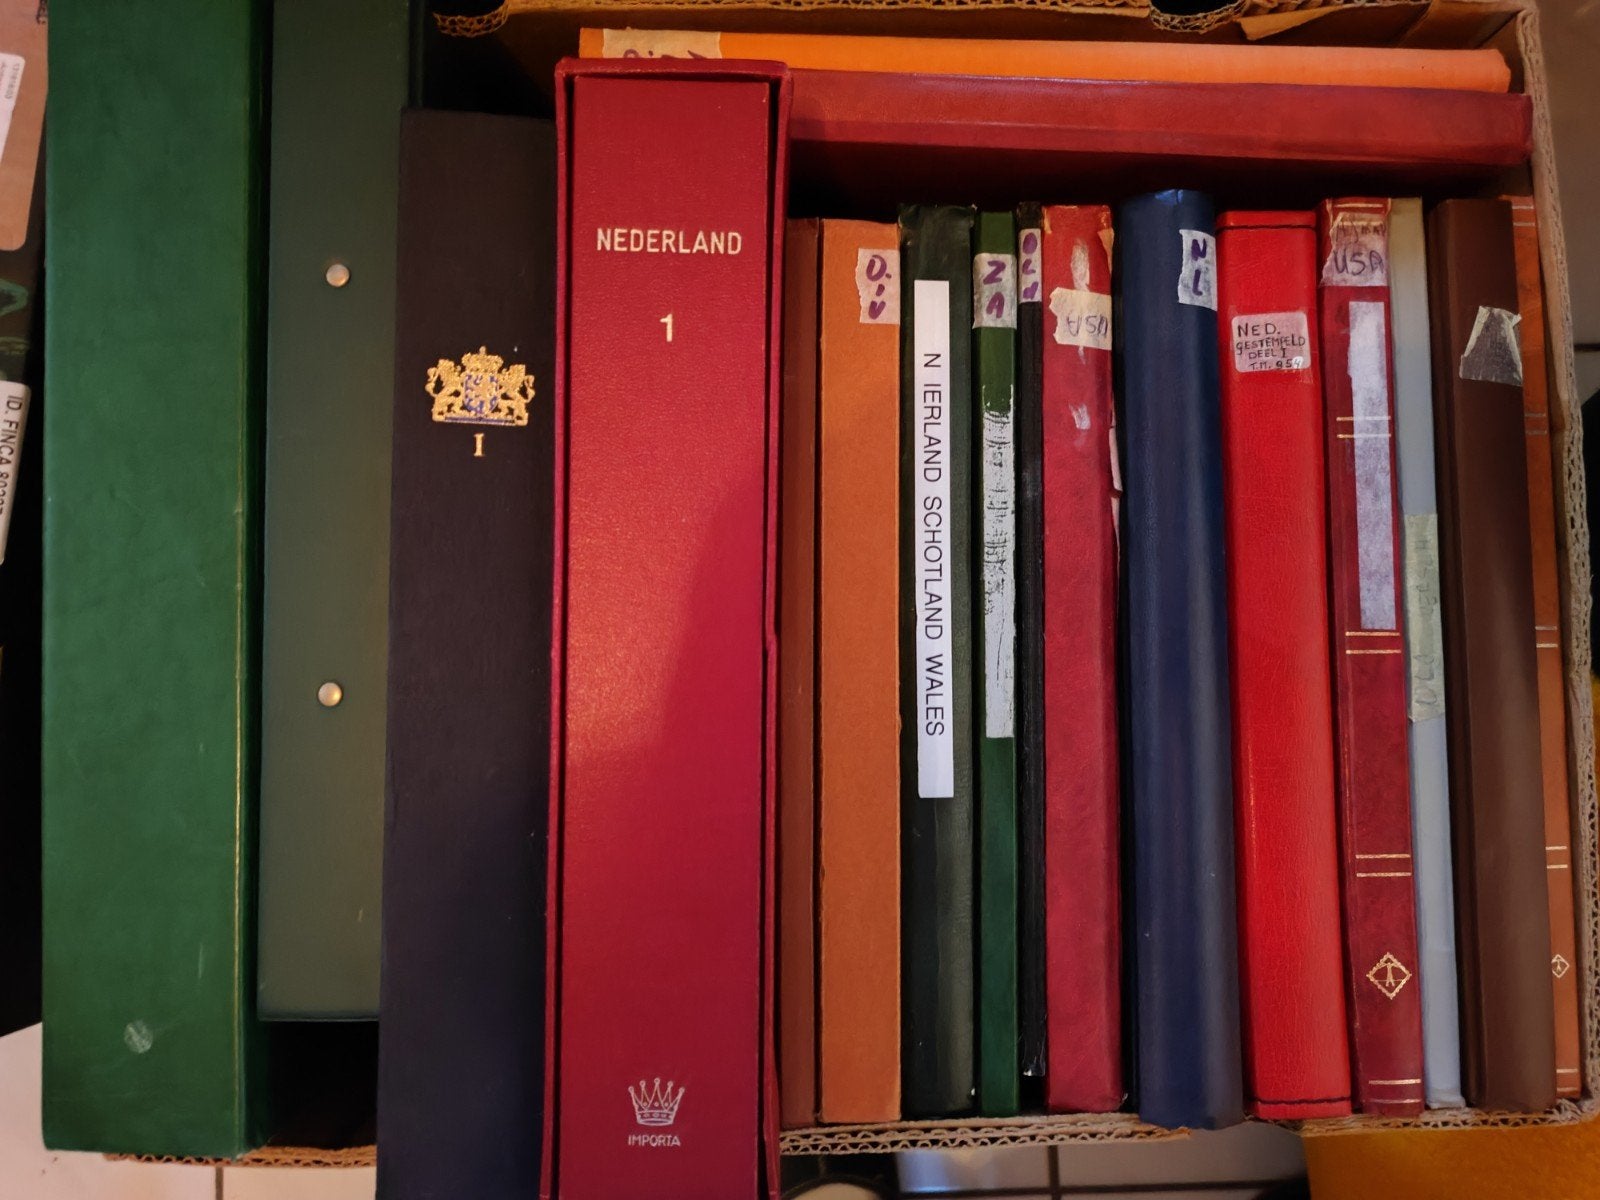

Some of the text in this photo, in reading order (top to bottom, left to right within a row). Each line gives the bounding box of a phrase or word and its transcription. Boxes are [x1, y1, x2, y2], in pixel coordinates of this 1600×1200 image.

[596, 227, 742, 255] NEDERLAND
[1332, 248, 1385, 276] USA
[982, 260, 1007, 319] ZA
[659, 313, 673, 343] 1
[1237, 322, 1281, 338] NED.
[1248, 348, 1277, 360] DEEL
[5, 395, 23, 414] ID.
[923, 383, 942, 483] IERLAND
[923, 495, 943, 640] SCHOTLAND
[925, 653, 945, 737] WALES
[628, 1134, 681, 1147] IMPORTA
